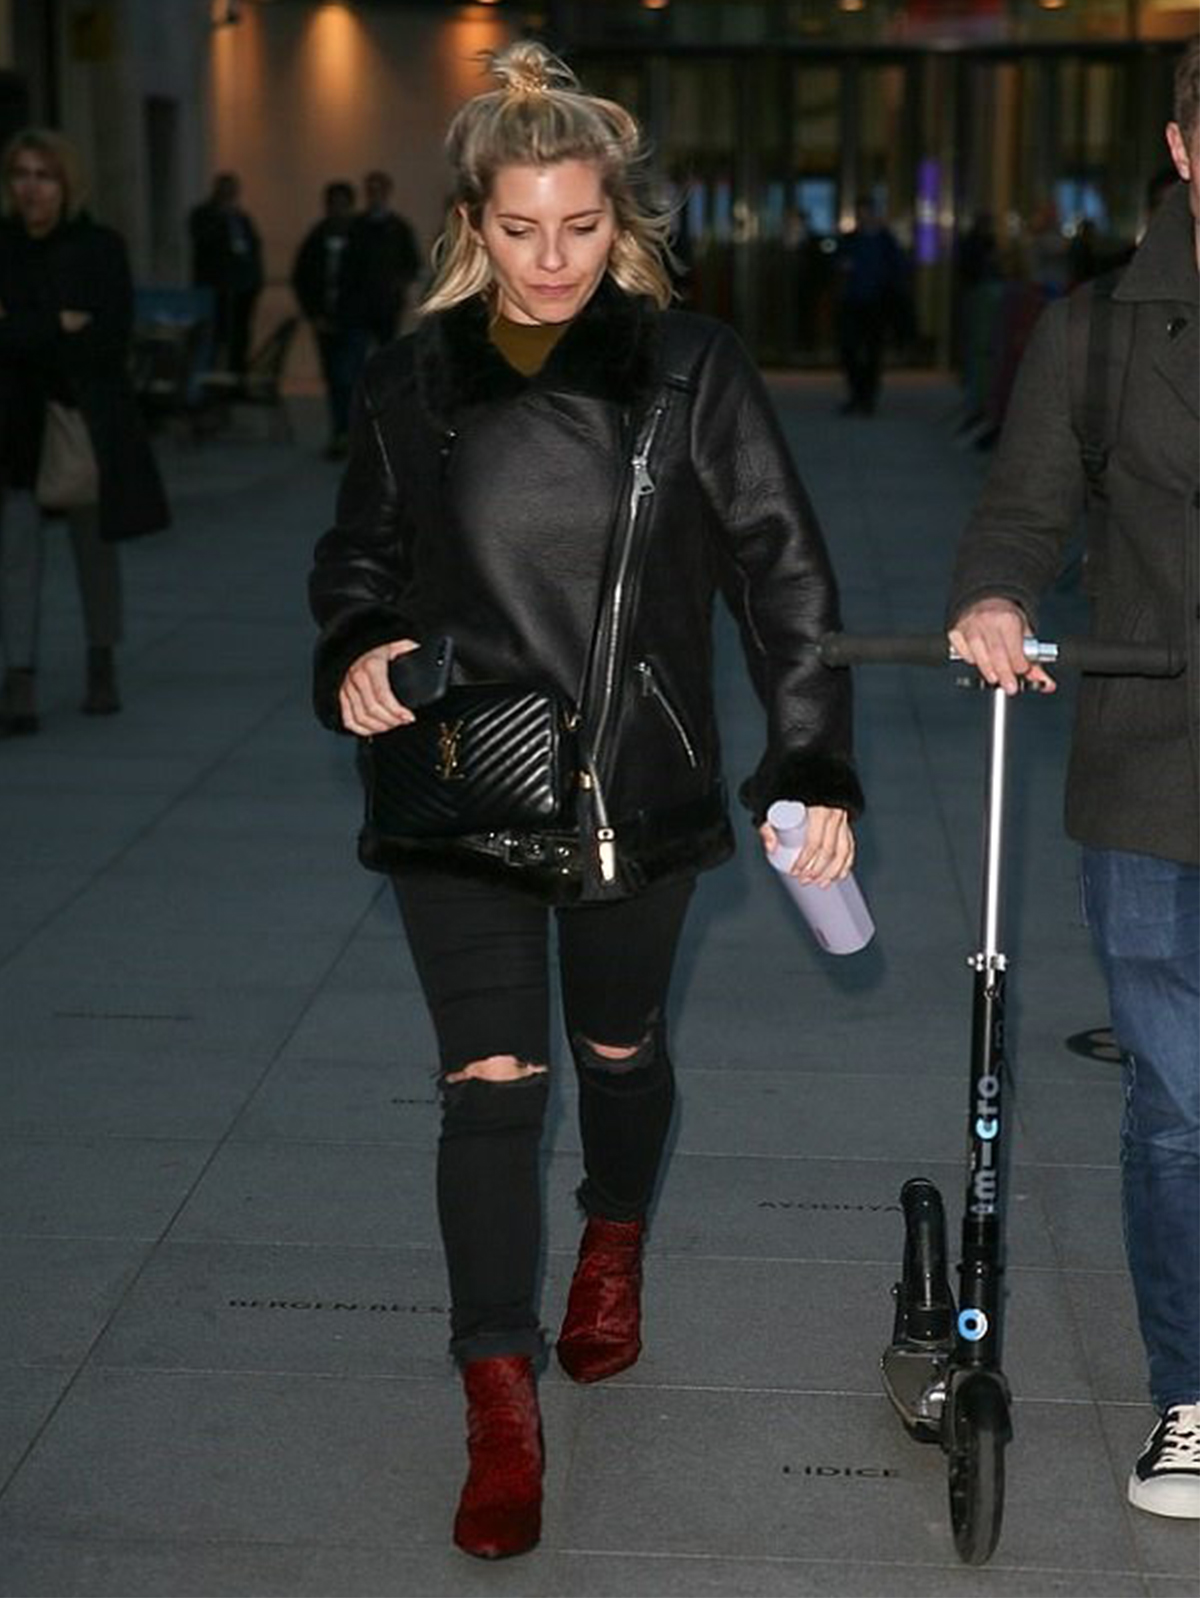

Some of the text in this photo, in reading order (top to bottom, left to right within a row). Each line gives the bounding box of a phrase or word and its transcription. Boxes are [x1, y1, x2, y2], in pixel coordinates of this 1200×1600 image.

[974, 1075, 1000, 1201] micro
[229, 1298, 452, 1314] BERGEN-BELS
[782, 1465, 899, 1478] LIDICE
